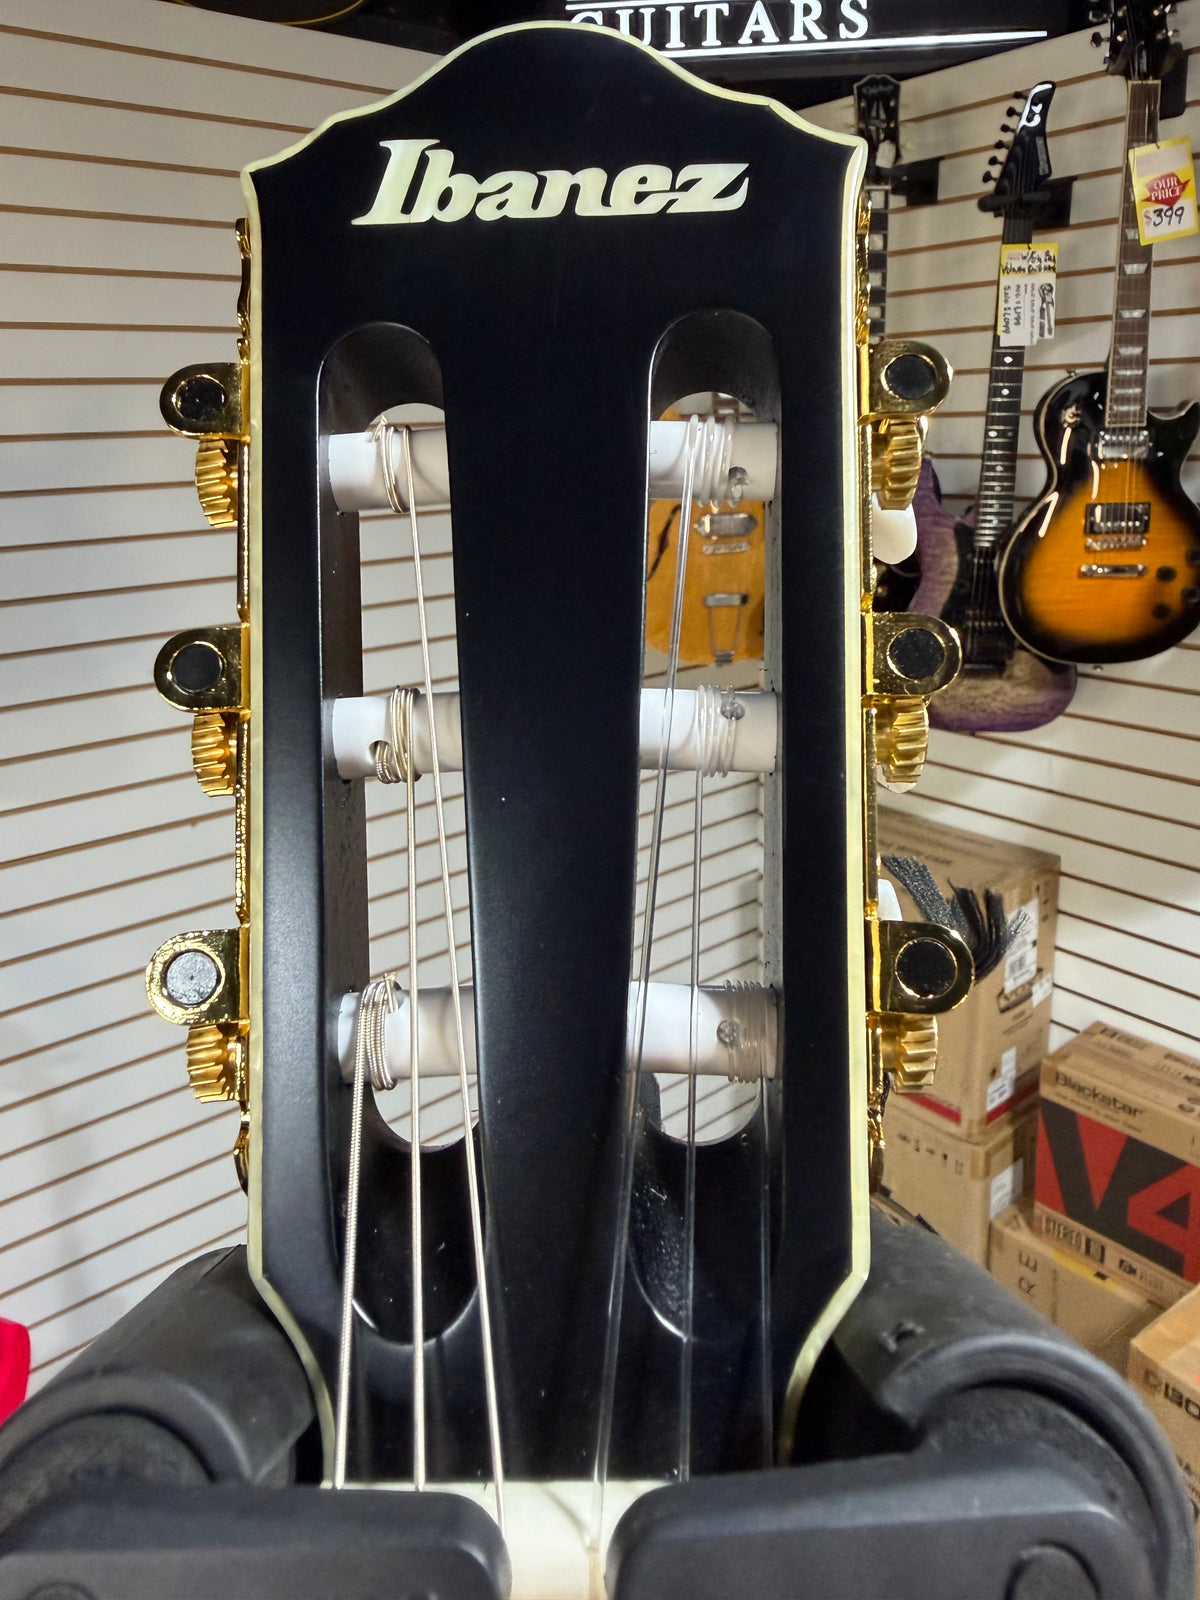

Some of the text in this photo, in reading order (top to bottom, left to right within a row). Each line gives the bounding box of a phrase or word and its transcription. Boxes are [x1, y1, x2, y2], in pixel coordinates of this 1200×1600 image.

[351, 138, 749, 225] Ibanez
[1153, 176, 1178, 191] OUR
[1151, 185, 1181, 201] PRICE
[1144, 206, 1185, 227] $399
[1055, 1071, 1143, 1119] Blackstar
